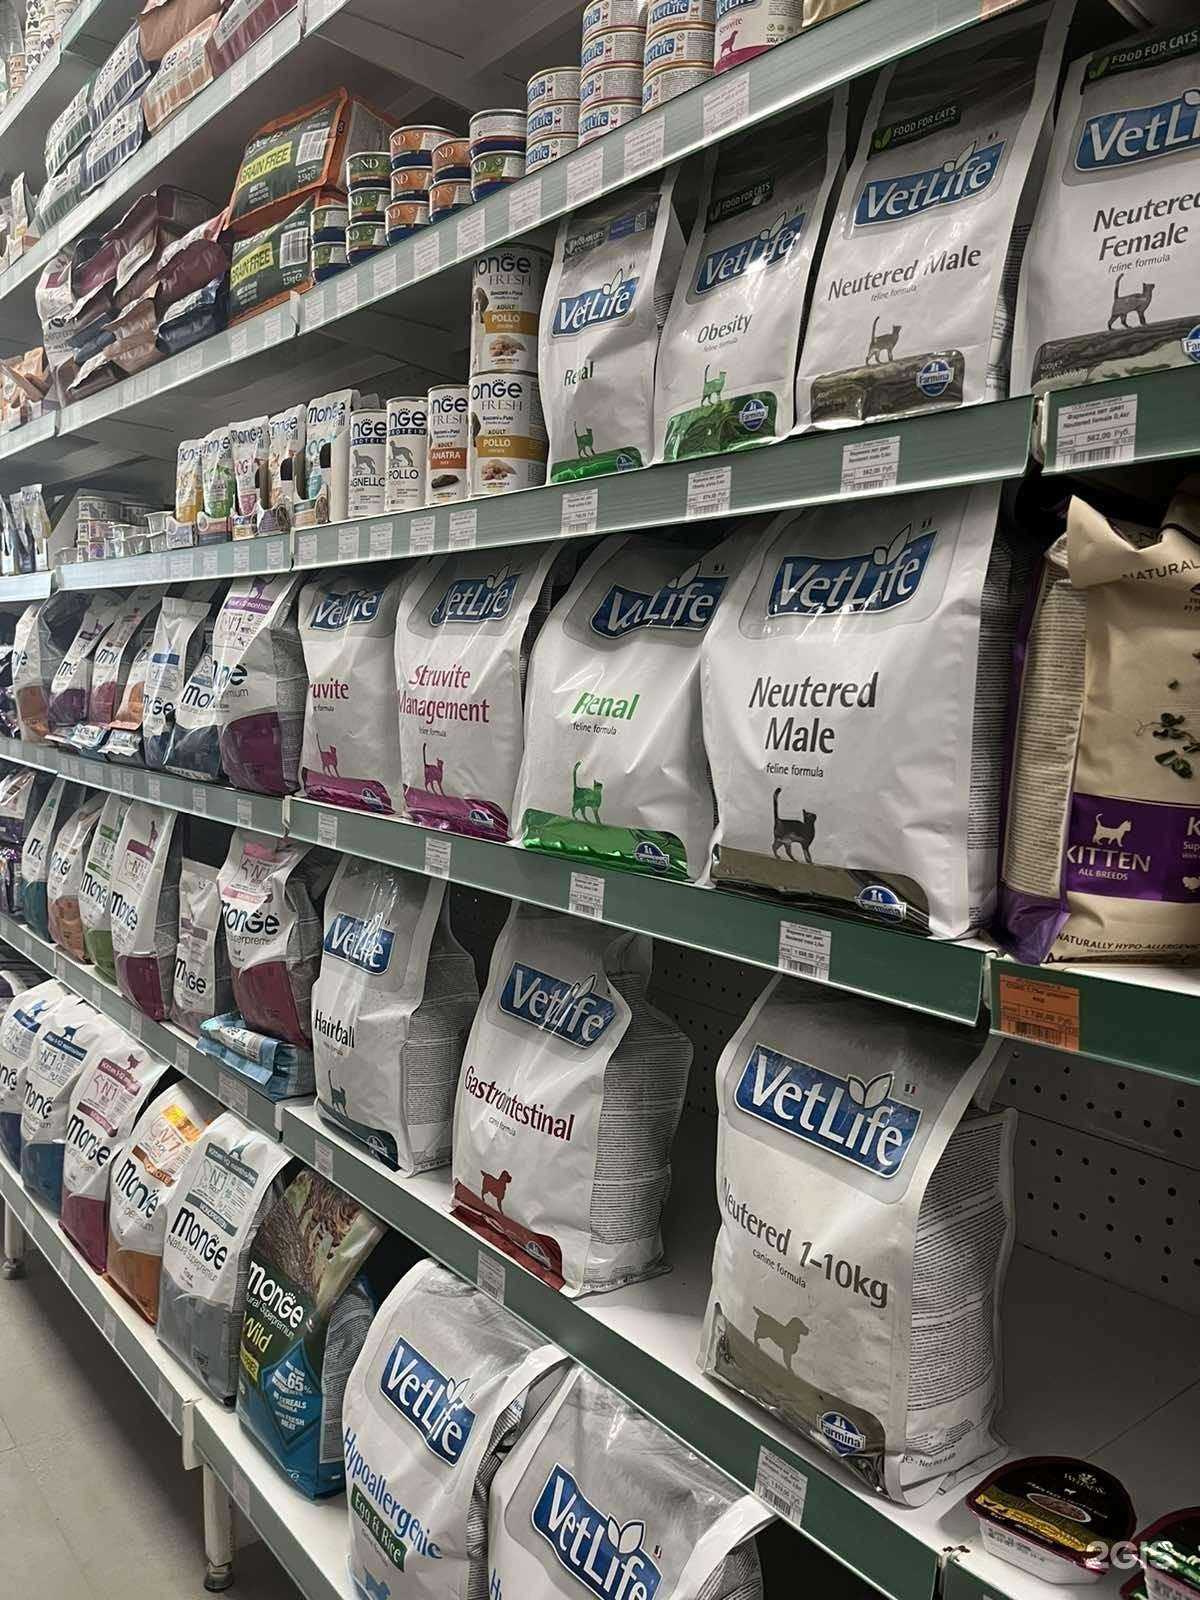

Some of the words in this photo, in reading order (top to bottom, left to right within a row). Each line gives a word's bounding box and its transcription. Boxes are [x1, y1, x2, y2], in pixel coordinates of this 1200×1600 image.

[1145, 40, 1166, 58] FOR
[1169, 30, 1198, 51] CATS
[866, 154, 992, 218] VetLife
[1099, 223, 1189, 261] Female
[828, 259, 920, 301] Neutered
[922, 245, 981, 278] Male
[491, 314, 521, 323] POLLO
[559, 286, 631, 332] VetLife
[697, 313, 752, 343] Obesity
[431, 451, 461, 460] ANATRA
[482, 440, 511, 448] POLLO
[386, 469, 419, 480] POLLO
[778, 549, 920, 609] VetLife
[1121, 560, 1200, 580] ATURAL
[607, 582, 714, 632] VLife
[308, 678, 350, 700] uvite
[408, 664, 471, 689] Struvite
[748, 672, 880, 709] Neutered
[573, 691, 640, 721] Renal
[765, 717, 835, 754] Male
[766, 763, 789, 775] feline
[791, 765, 824, 778] formula
[1066, 845, 1151, 873] KITTEN
[1096, 870, 1129, 881] BREEDS
[1056, 932, 1115, 950] NATURALLY
[514, 968, 604, 1043] VetLife
[314, 1008, 355, 1049] Hairball
[751, 1053, 904, 1166] VetLife
[752, 1248, 776, 1271] canine
[776, 1261, 807, 1289] formula
[799, 1240, 889, 1309] 1-10kg
[386, 1346, 464, 1458] VetLife
[822, 1422, 863, 1450] Farmina
[343, 1426, 443, 1560] Hypoallergenic
[354, 1494, 371, 1526] Egg
[382, 1529, 401, 1564] Rice
[548, 1474, 648, 1600] VetLife
